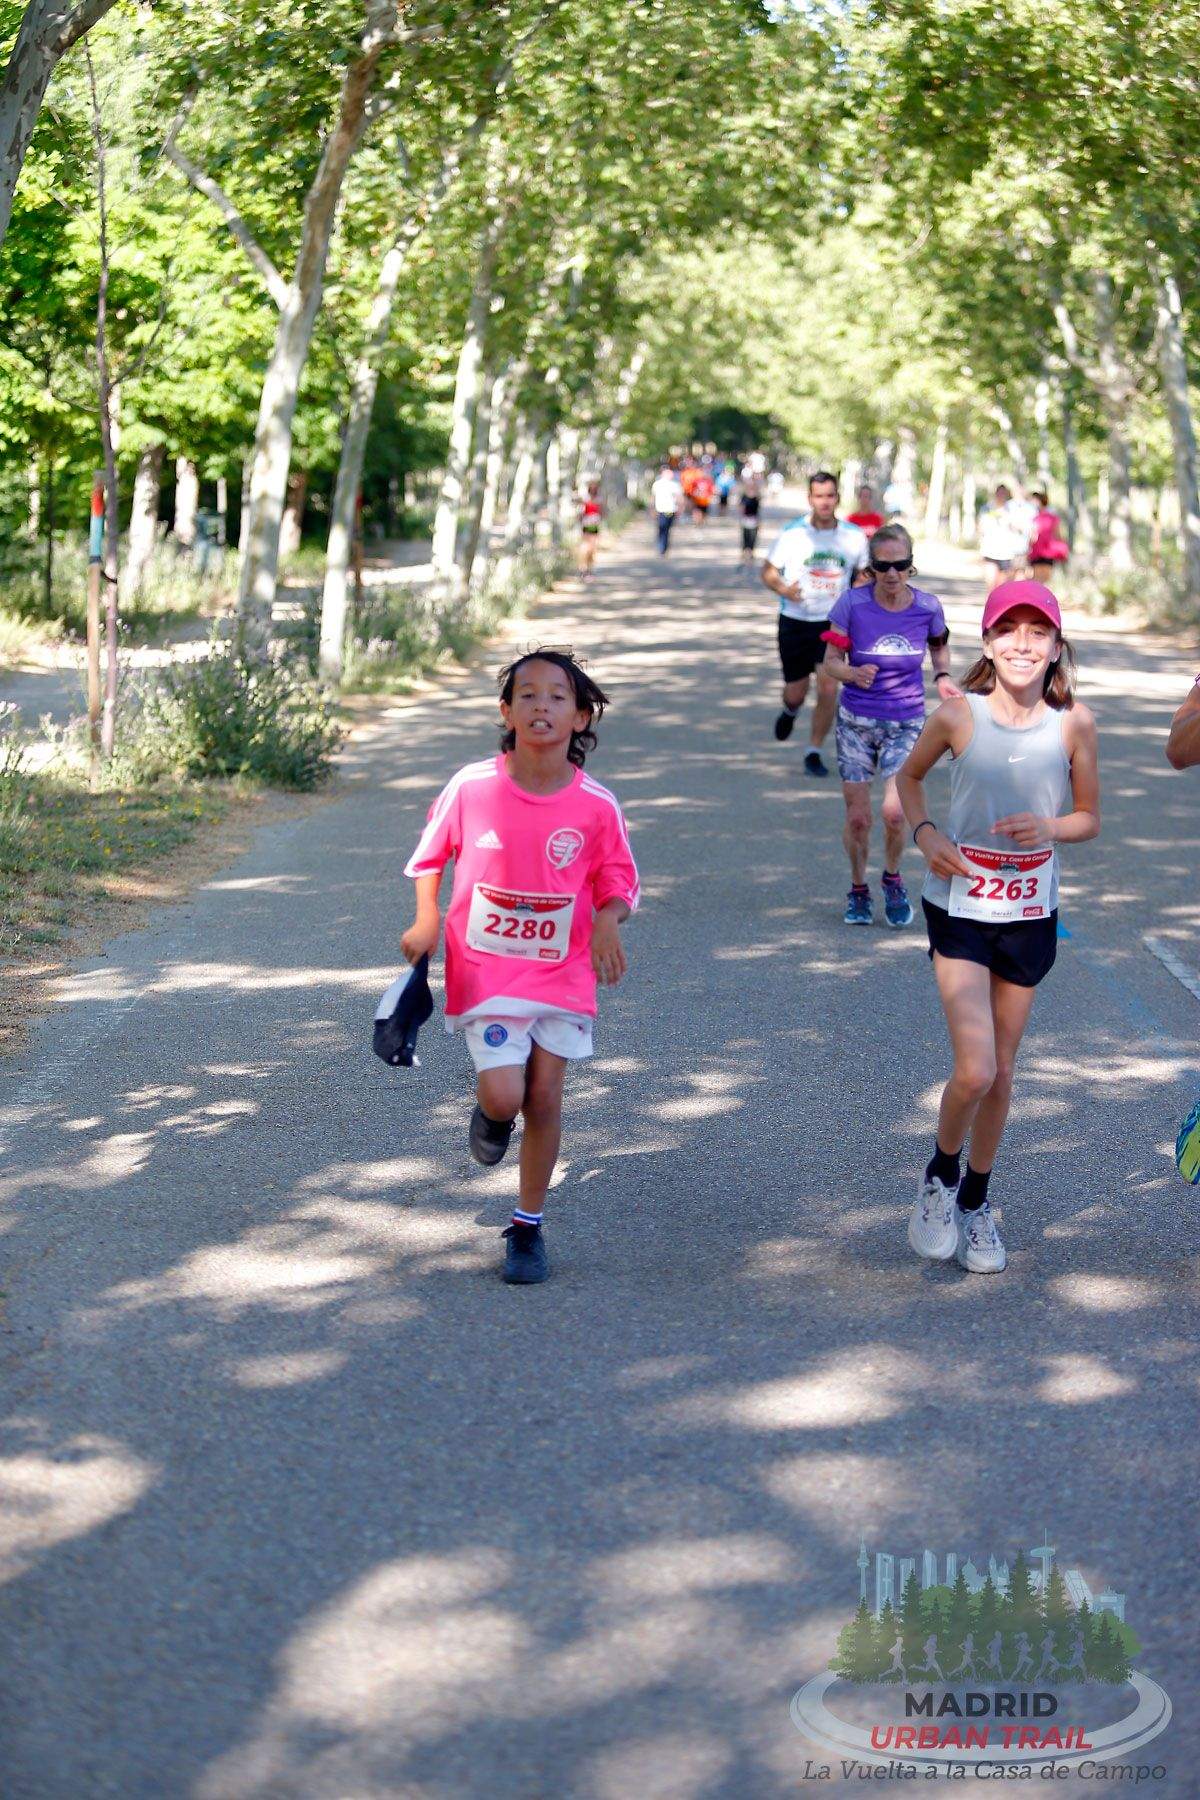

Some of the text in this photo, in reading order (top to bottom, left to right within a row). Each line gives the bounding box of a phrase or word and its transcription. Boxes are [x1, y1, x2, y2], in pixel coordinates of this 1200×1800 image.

[974, 852, 994, 861] Vuelta
[1032, 853, 1050, 862] Campo
[967, 875, 1039, 901] 2263
[483, 913, 556, 941] 2280
